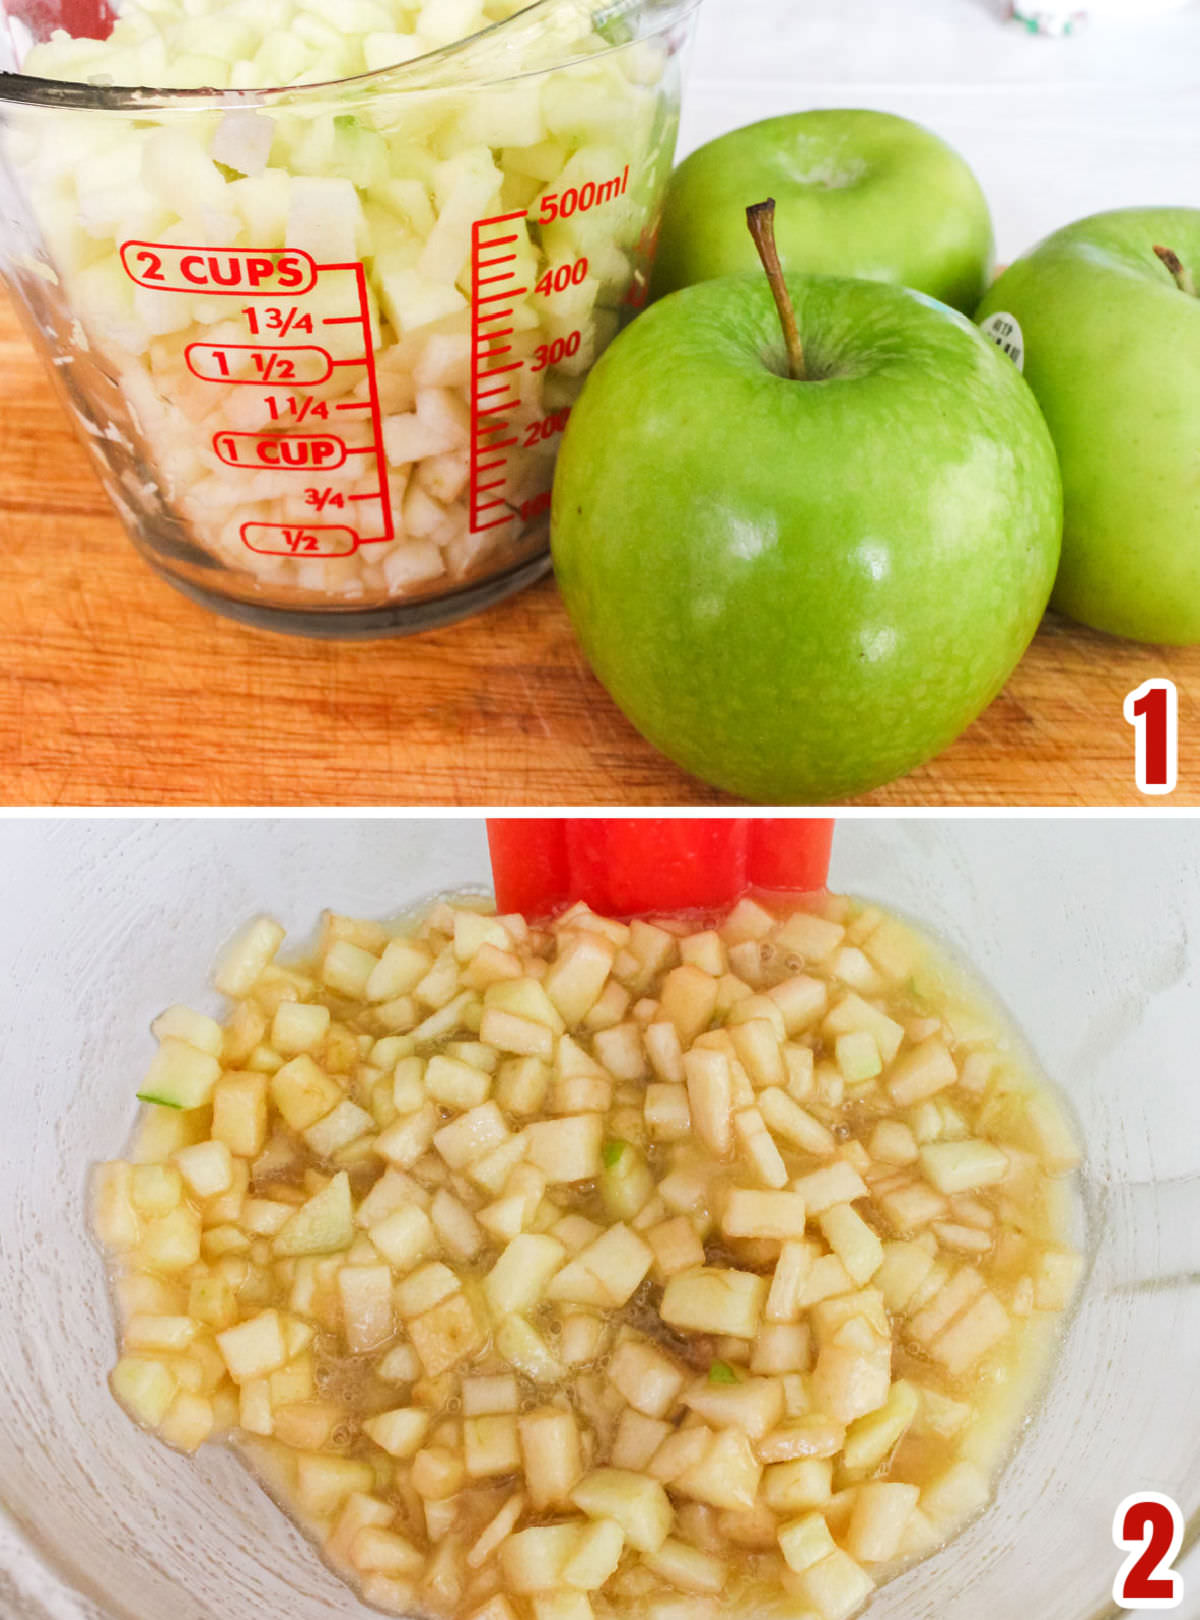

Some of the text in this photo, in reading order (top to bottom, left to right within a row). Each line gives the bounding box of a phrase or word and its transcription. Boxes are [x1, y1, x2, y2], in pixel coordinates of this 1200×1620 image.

[538, 164, 629, 226] 500ml
[136, 251, 304, 288] 2 CUPS
[534, 257, 589, 297] 400
[212, 351, 230, 377] 1
[530, 330, 582, 373] 300
[222, 438, 335, 466] 1 CUP
[304, 487, 345, 512] 3/4
[282, 529, 320, 553] 1/2
